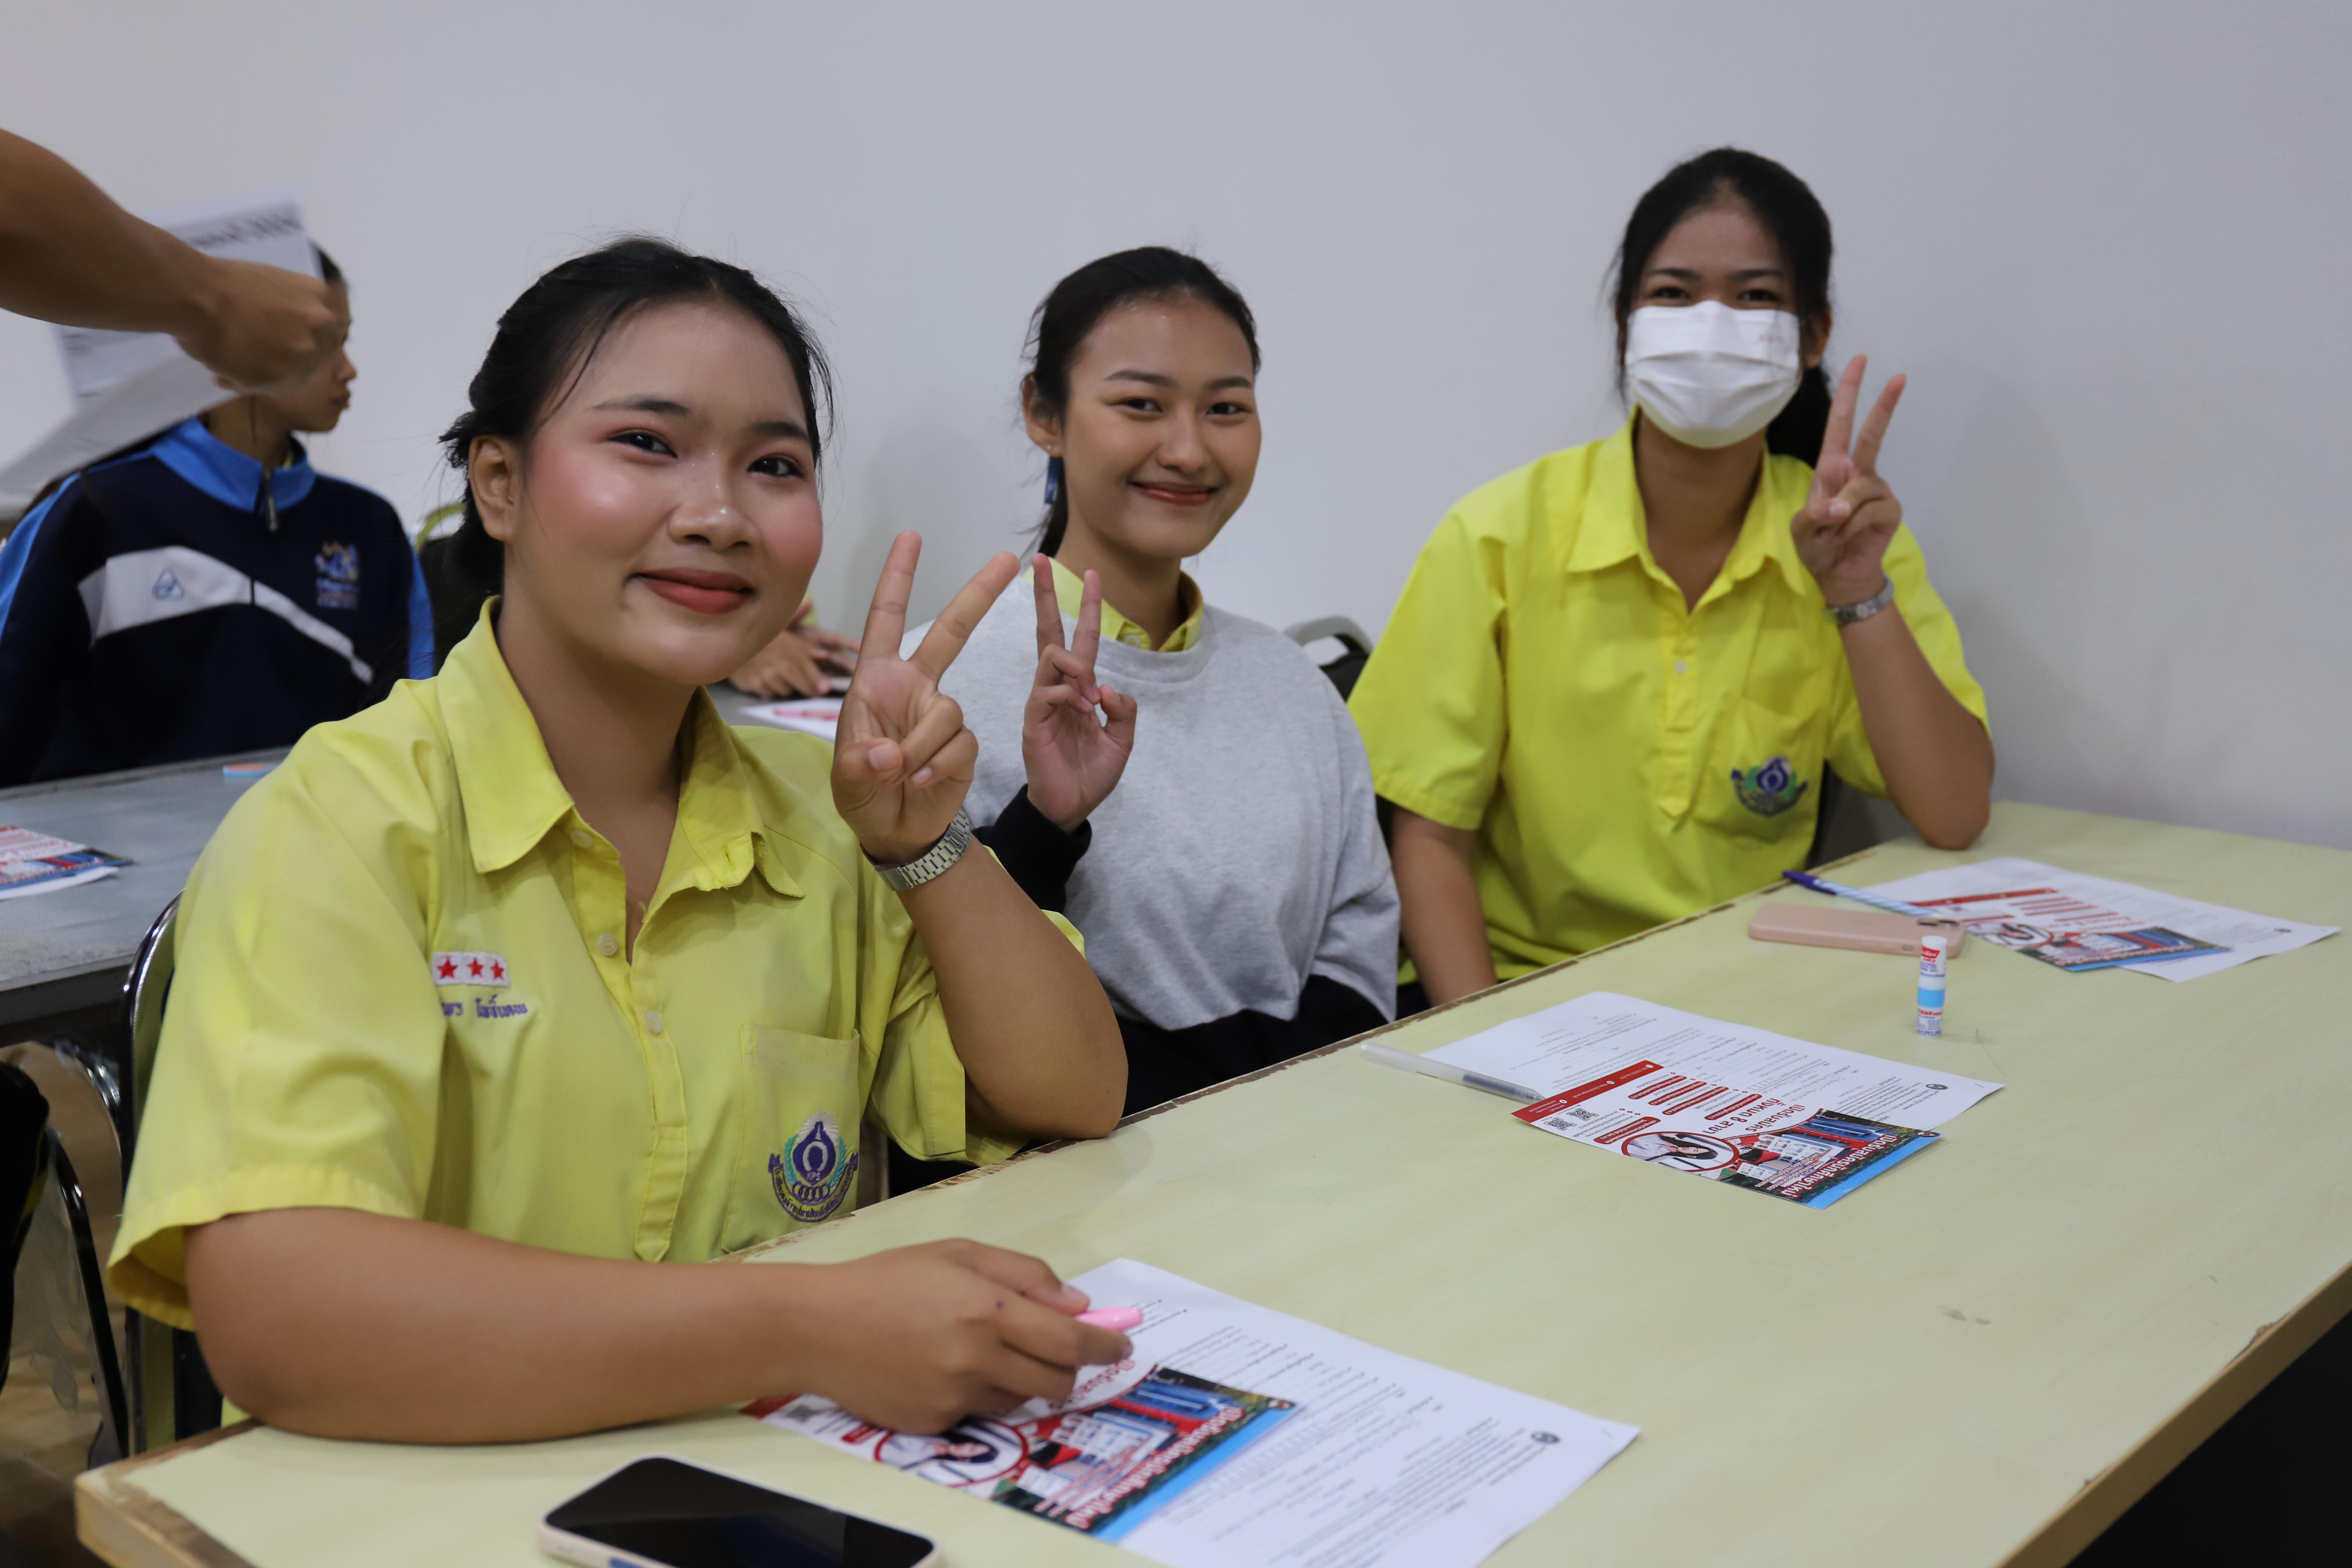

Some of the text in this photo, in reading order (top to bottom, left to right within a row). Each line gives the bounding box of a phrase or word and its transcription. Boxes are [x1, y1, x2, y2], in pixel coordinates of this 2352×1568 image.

[1740, 1098, 1784, 1118] ทั้งหมด
[1703, 1121, 1733, 1134] สาขา
[1745, 1104, 1805, 1133] เปิดรับสมัคร
[1779, 1134, 1896, 1197] เปิดรับสมัครนักศึกษาใหม่
[807, 1171, 821, 1181] KPS
